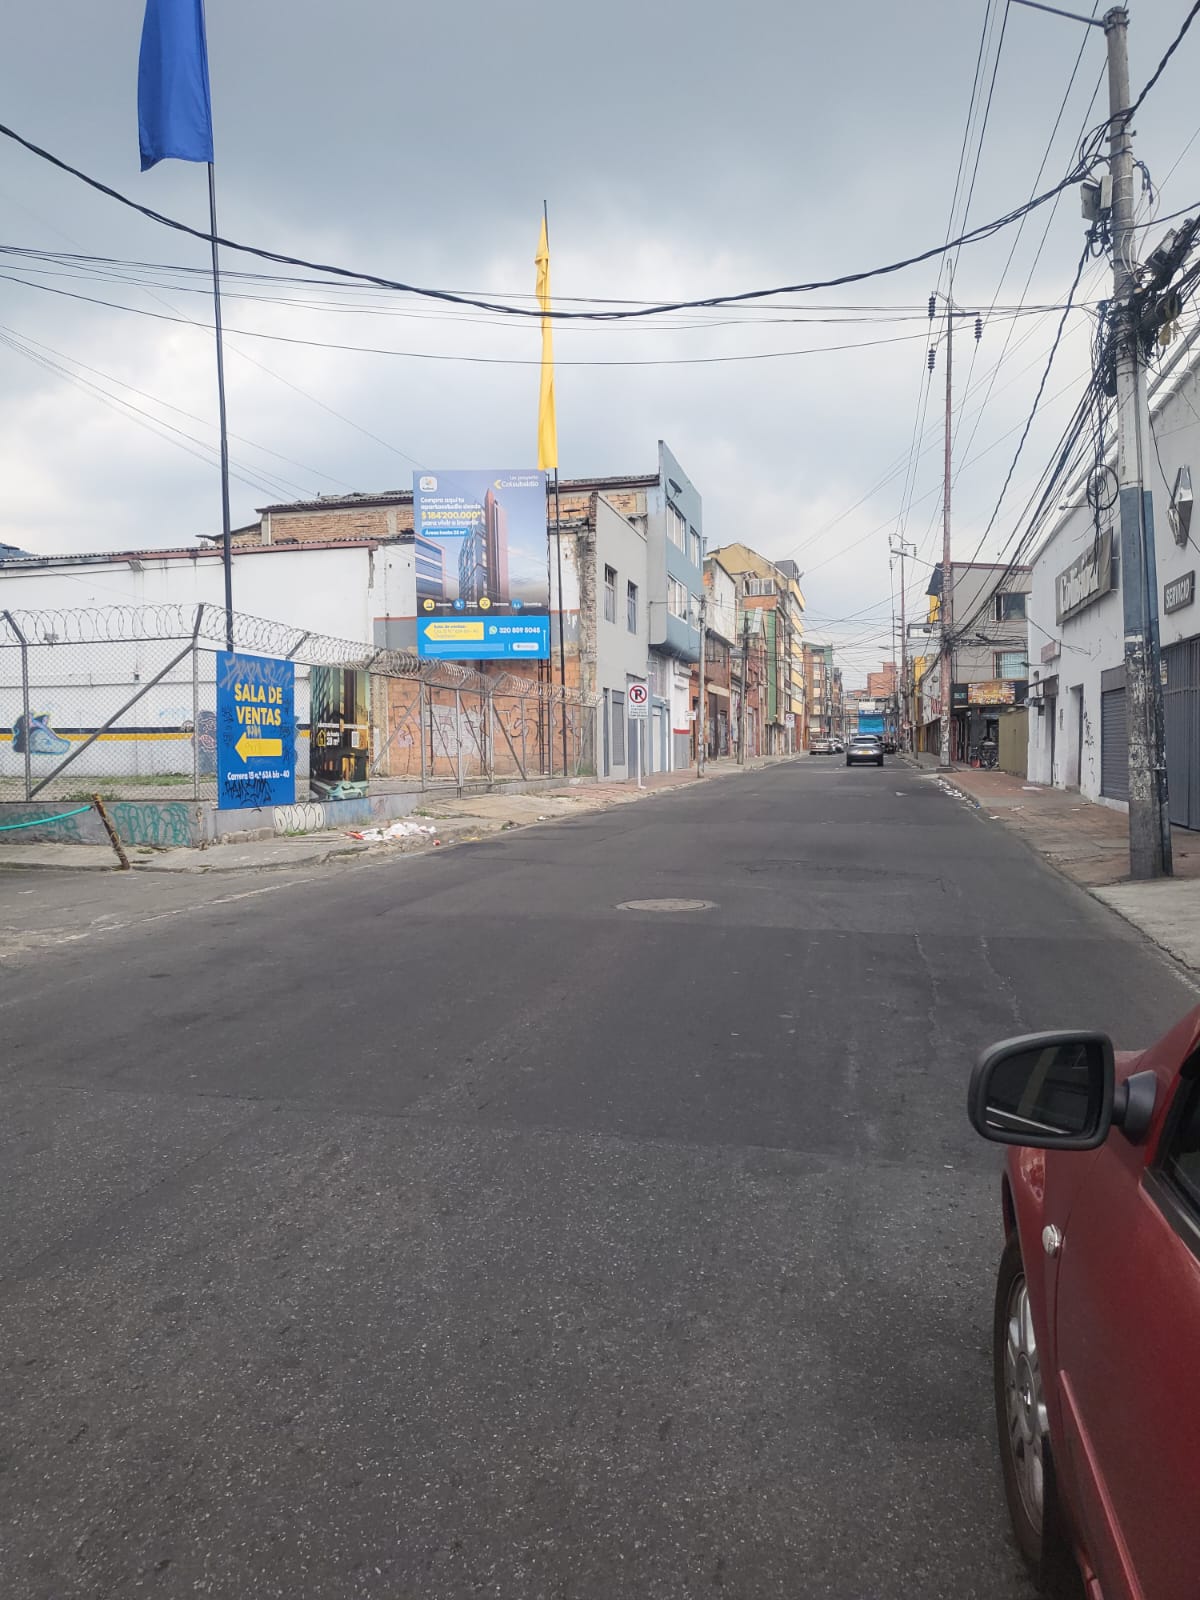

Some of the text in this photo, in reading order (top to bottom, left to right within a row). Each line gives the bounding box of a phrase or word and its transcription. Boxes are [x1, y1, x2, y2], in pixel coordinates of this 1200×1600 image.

[1166, 578, 1190, 608] SERVICIO
[234, 683, 283, 705] SALA DE
[236, 706, 281, 726] VENTAS
[227, 771, 248, 780] Carrera
